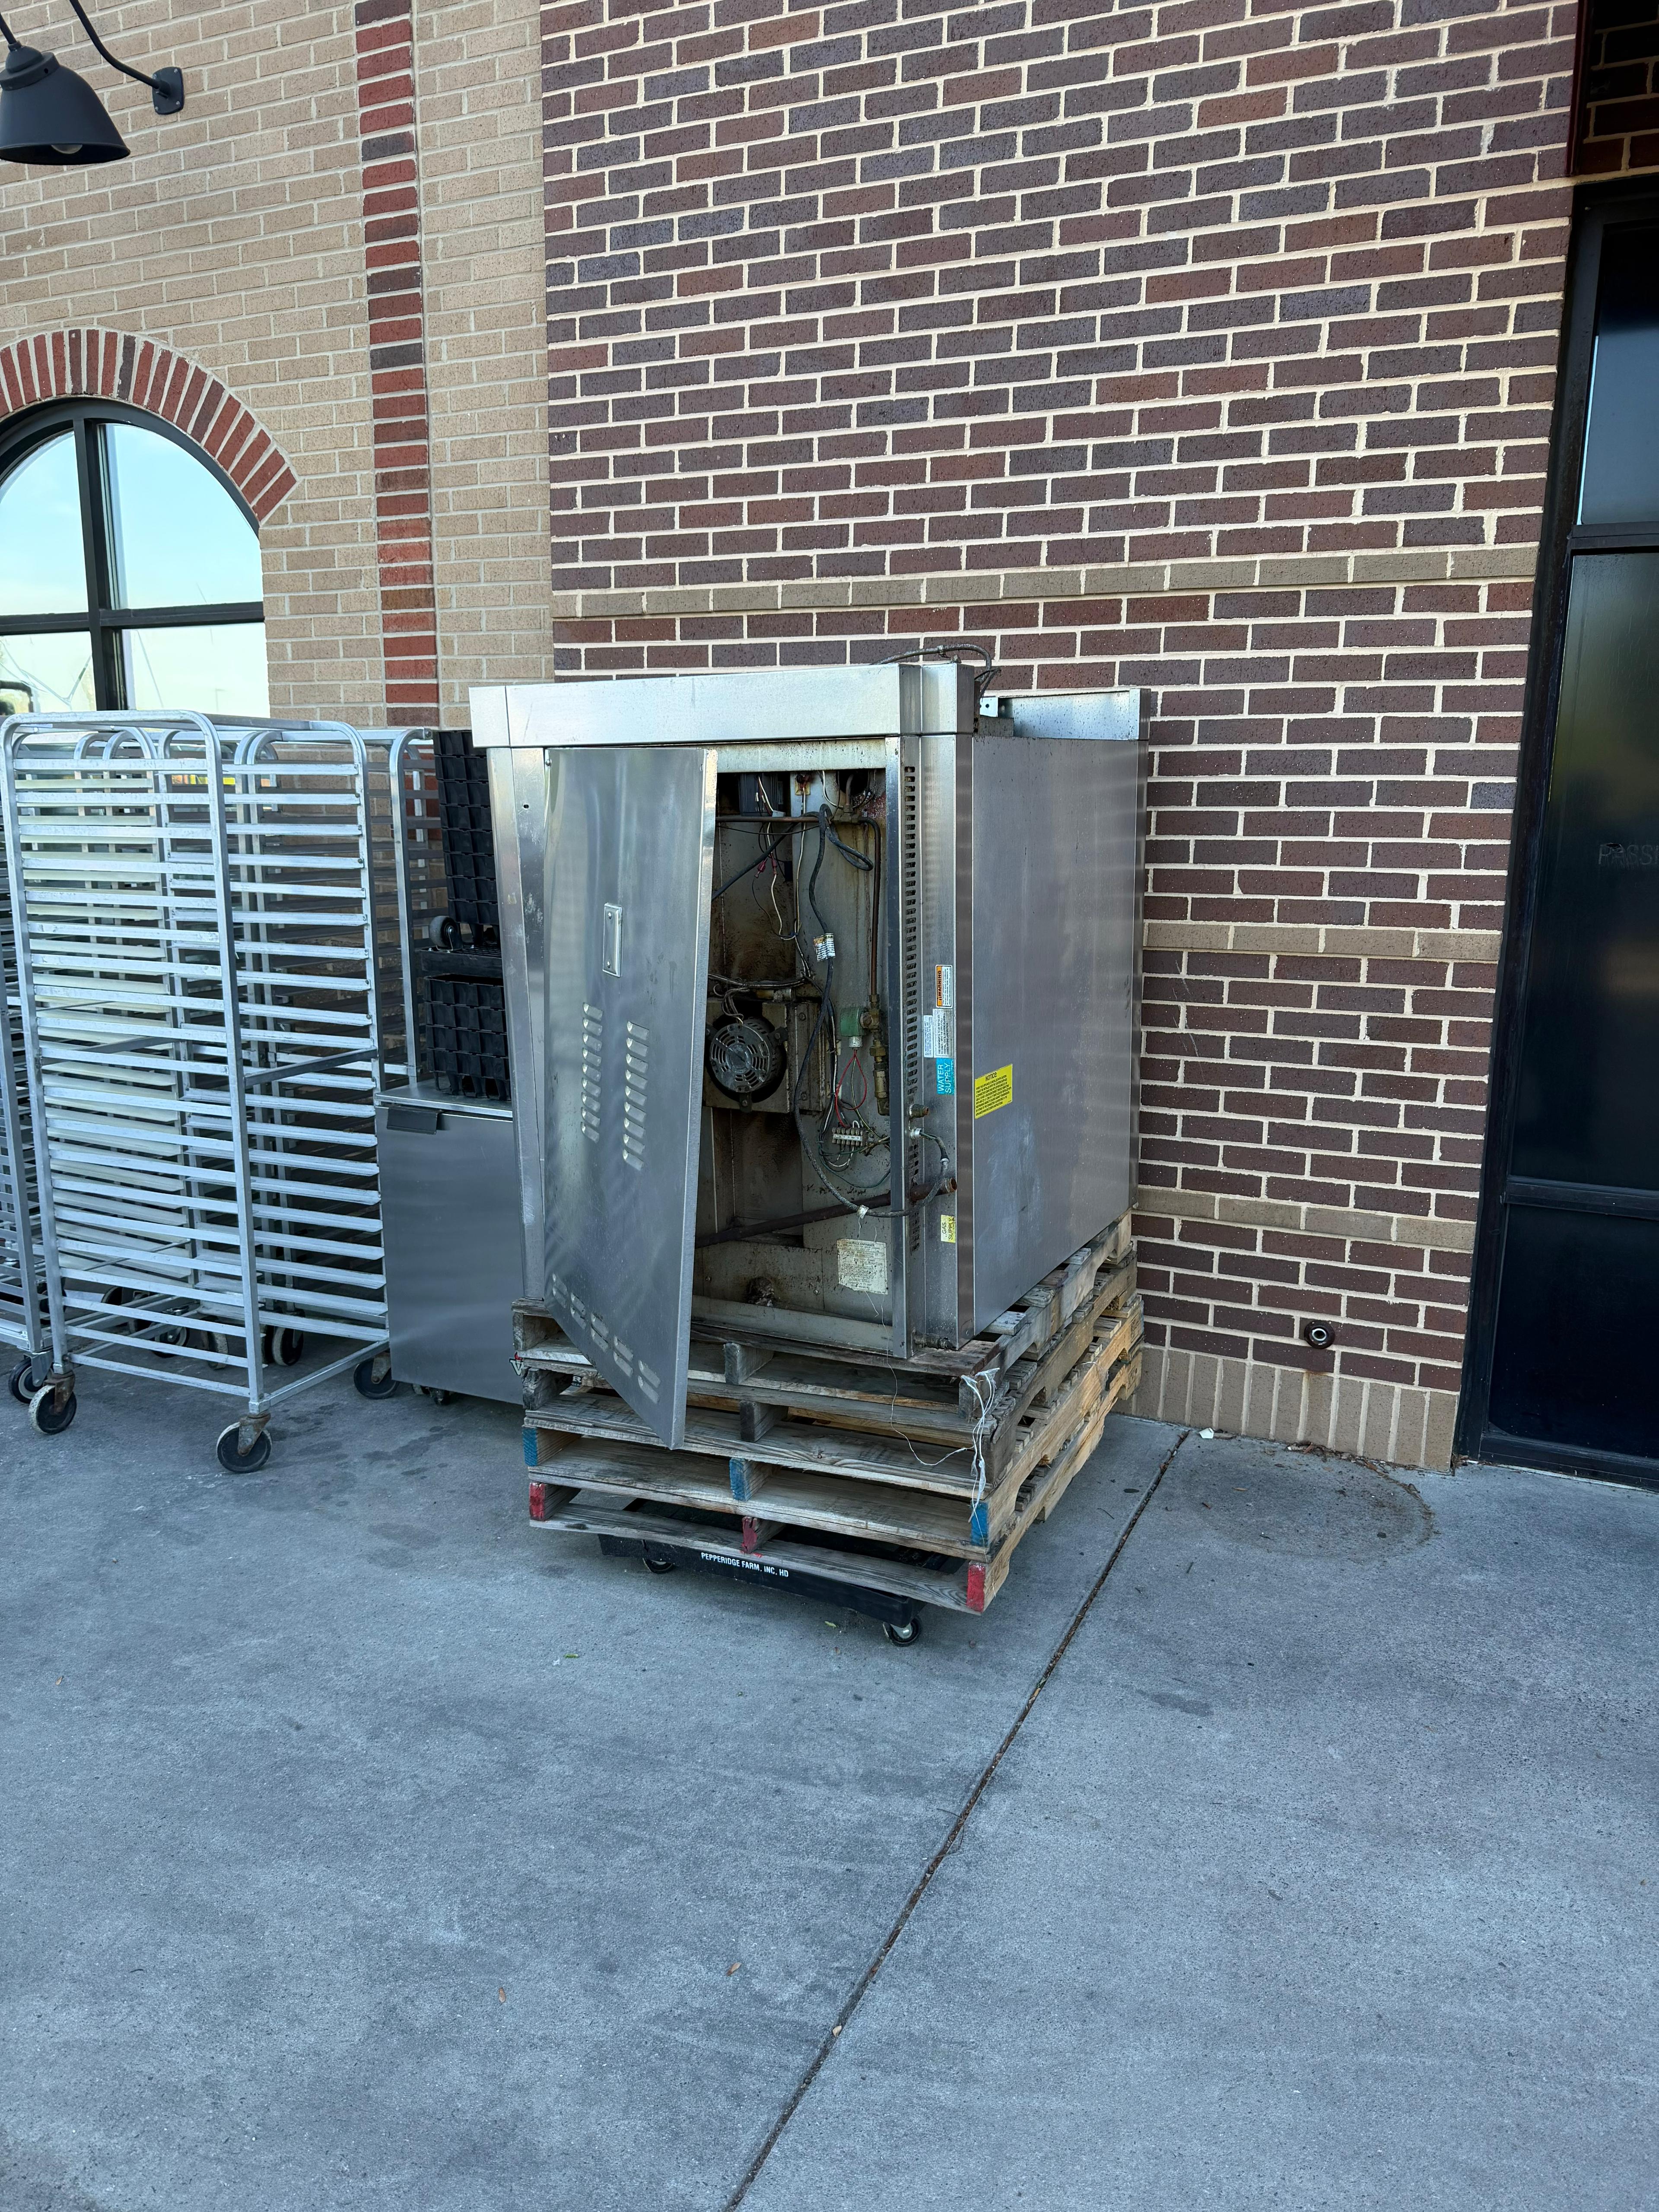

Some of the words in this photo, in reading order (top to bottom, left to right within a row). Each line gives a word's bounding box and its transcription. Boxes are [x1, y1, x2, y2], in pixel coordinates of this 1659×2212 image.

[985, 1072, 997, 1081] NOTICE
[701, 1552, 740, 1567] PEPPERIDGE
[764, 1566, 777, 1575] INC.
[779, 1569, 789, 1577] HD
